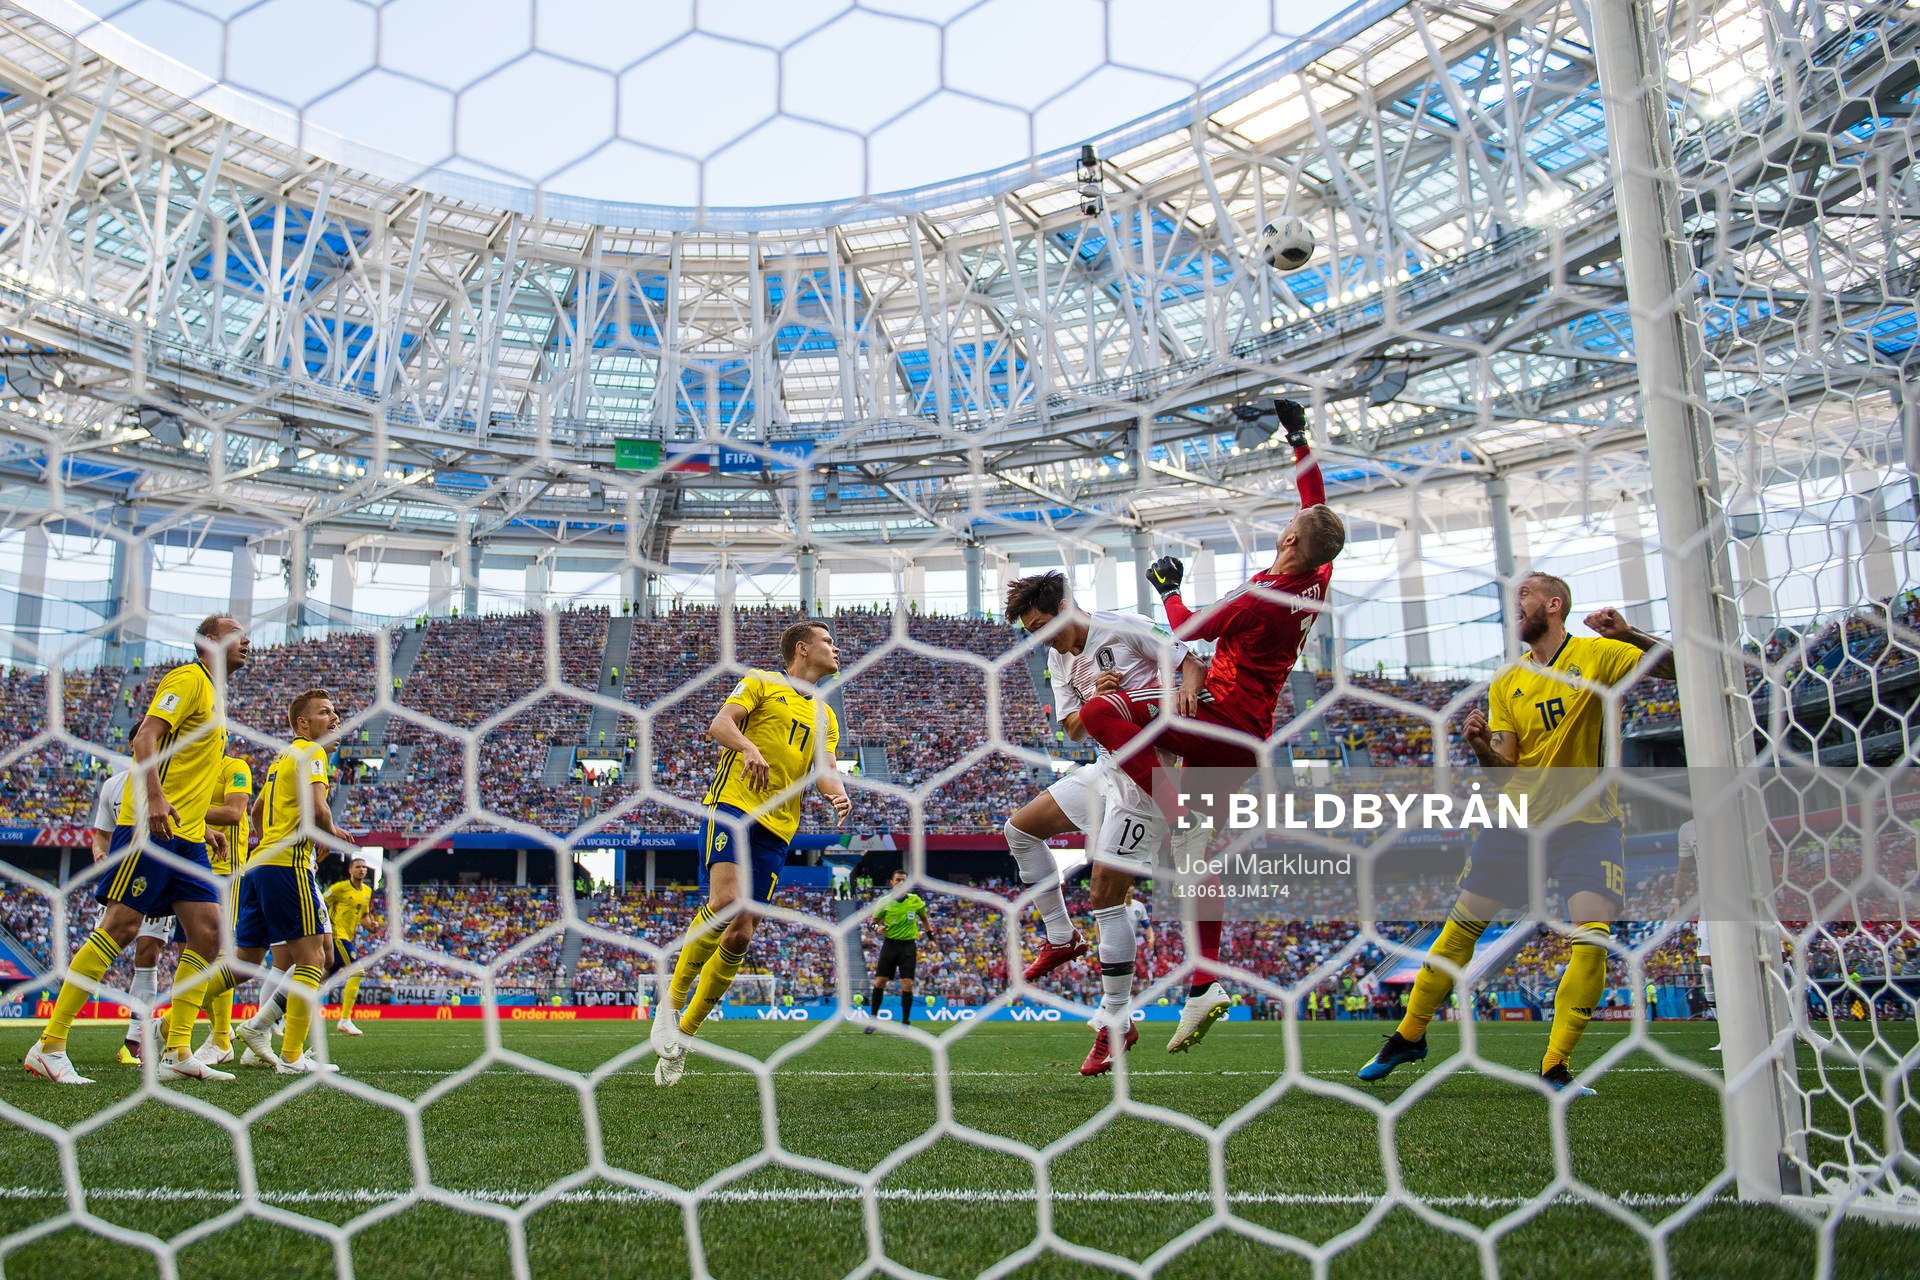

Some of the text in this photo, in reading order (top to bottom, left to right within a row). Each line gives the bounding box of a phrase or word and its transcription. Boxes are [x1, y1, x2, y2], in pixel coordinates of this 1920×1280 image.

[725, 453, 756, 464] FIFA
[788, 718, 811, 752] 17
[1120, 818, 1145, 850] 19
[587, 838, 620, 847] WORLD
[642, 838, 676, 847] RUSSIA
[1601, 860, 1624, 897] 18
[397, 989, 436, 1000] HALLE
[354, 1009, 381, 1019] now
[512, 1008, 577, 1020] Order now
[757, 1007, 808, 1021] vivo
[926, 1007, 977, 1021] vivo
[1010, 1007, 1061, 1021] vivo
